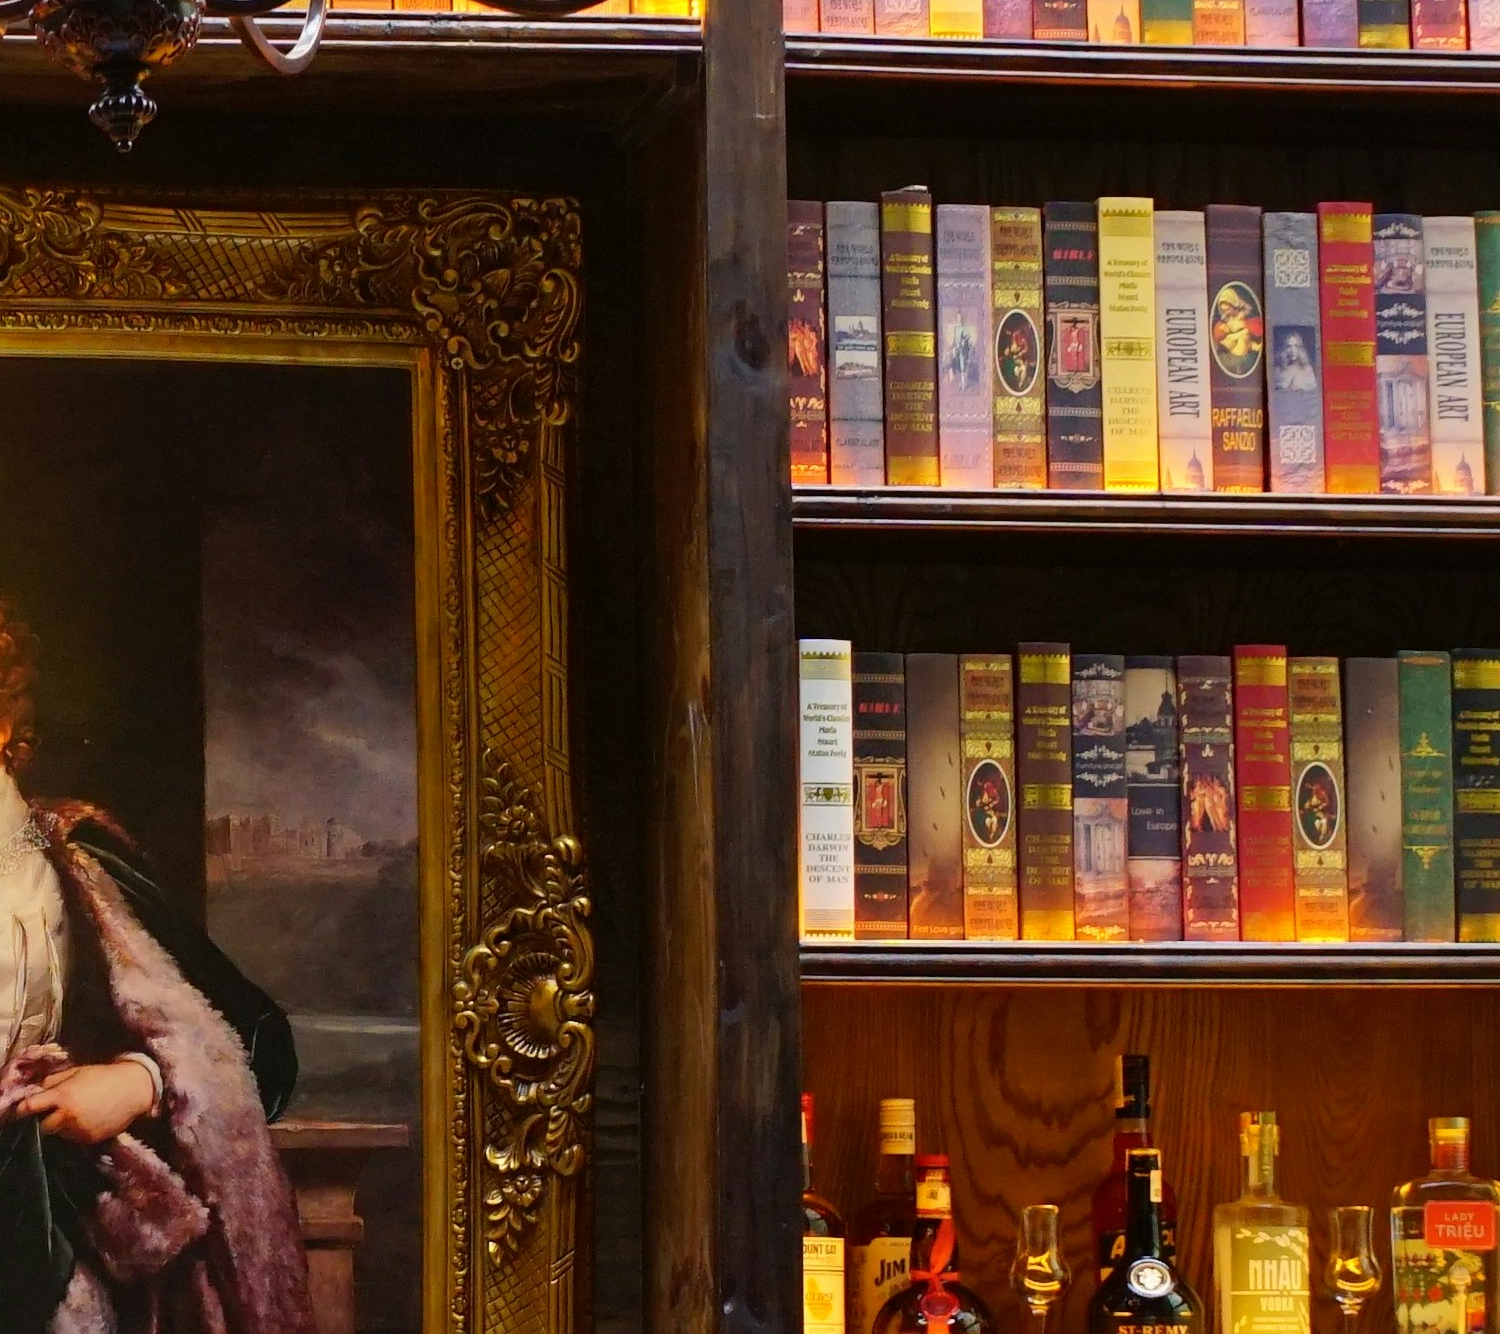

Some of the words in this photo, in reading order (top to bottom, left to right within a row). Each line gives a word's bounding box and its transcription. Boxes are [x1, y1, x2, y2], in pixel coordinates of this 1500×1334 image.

[1166, 308, 1198, 383] EUROPEAN
[1435, 312, 1468, 388] EUROPEAN
[1169, 390, 1200, 418] ART
[1212, 408, 1263, 428] RAFFAELLO
[1437, 394, 1469, 422] ART
[1222, 431, 1256, 451] SANZIO
[806, 864, 850, 872] DESCENT
[1443, 1212, 1475, 1222] LADY
[880, 1258, 907, 1286] JIM
